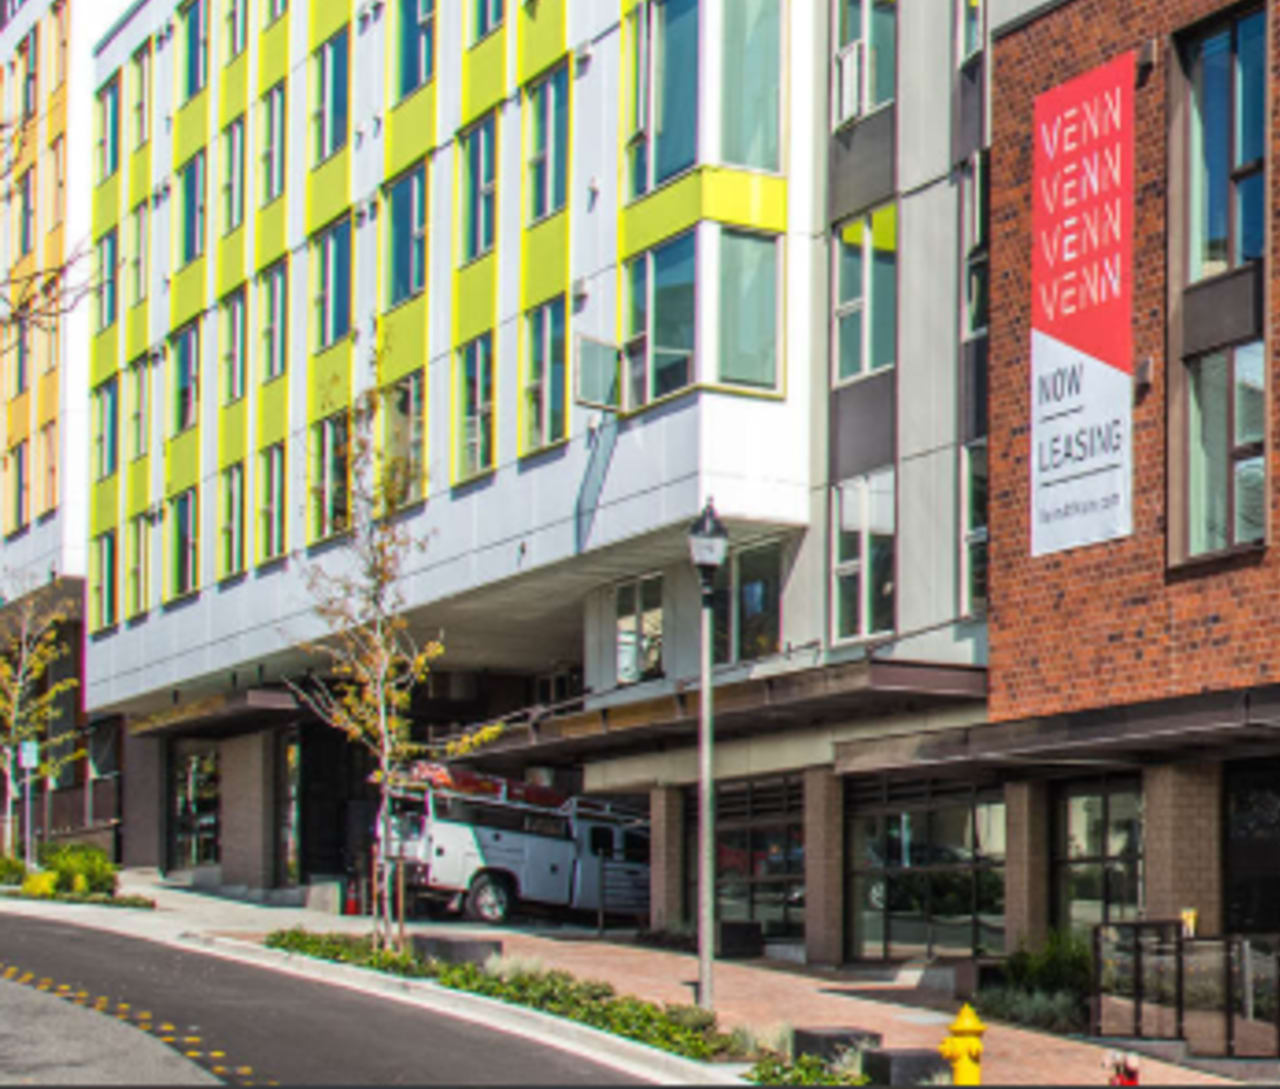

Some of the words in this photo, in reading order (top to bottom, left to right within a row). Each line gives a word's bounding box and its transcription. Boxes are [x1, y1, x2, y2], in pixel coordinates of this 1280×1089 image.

[1041, 86, 1121, 160] VENN
[1041, 143, 1121, 214] VENN
[1041, 198, 1121, 267] VENN
[1039, 253, 1121, 321] VENN
[1039, 363, 1083, 405] NOW
[1039, 419, 1121, 472] LEASING
